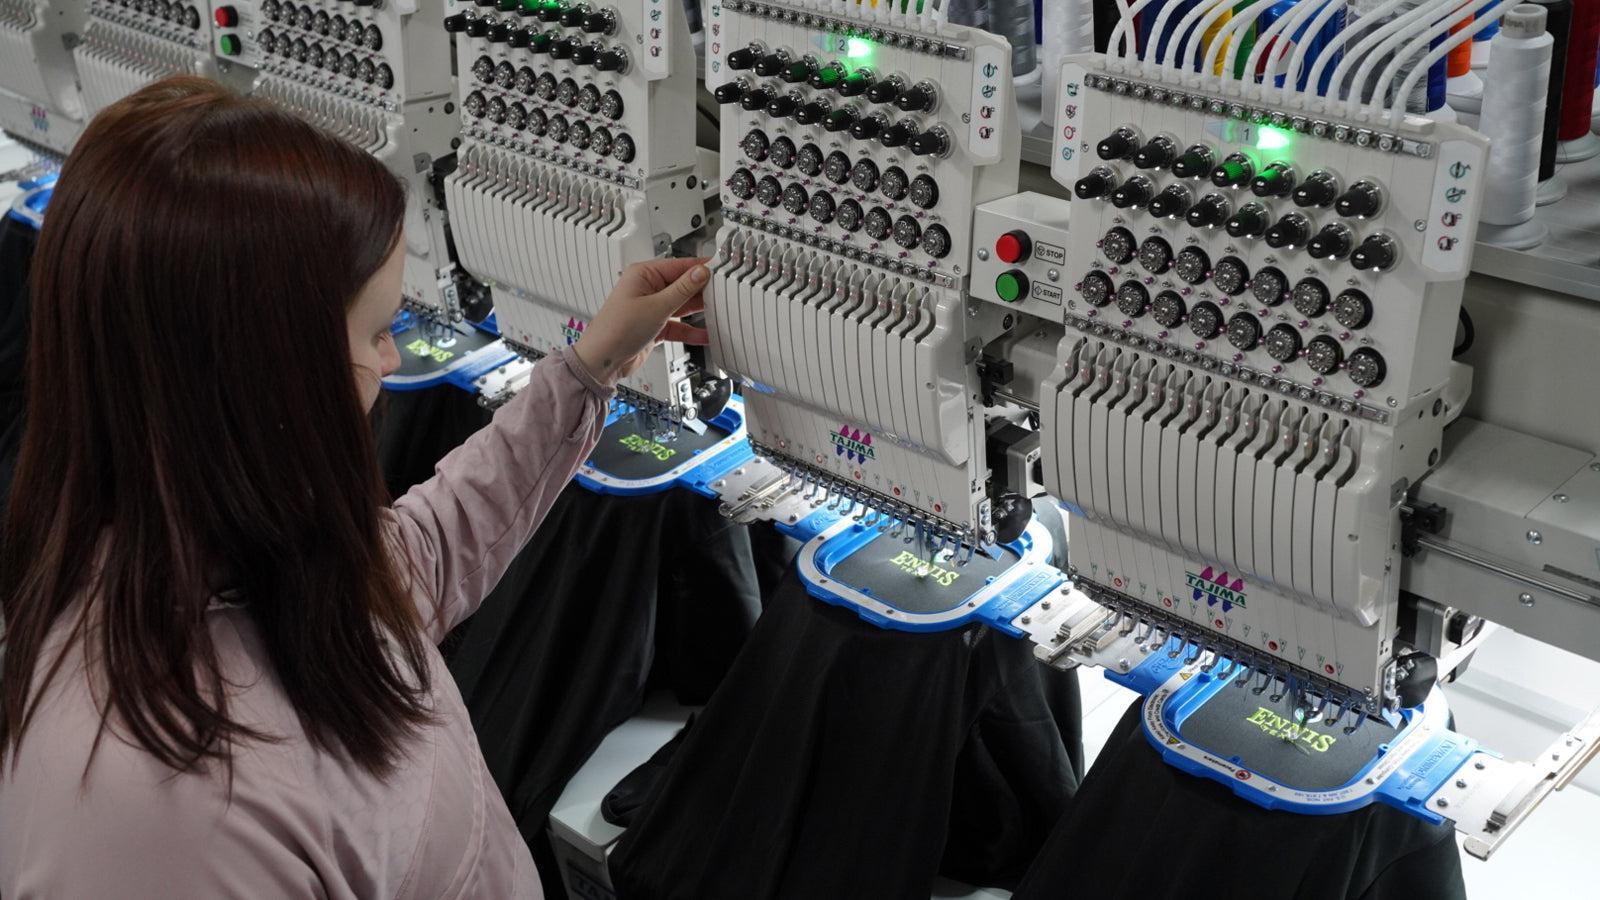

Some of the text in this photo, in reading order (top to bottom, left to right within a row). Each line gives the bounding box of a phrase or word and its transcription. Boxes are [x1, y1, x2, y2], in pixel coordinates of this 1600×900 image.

[838, 39, 846, 51] 2
[1243, 128, 1250, 141] 1
[1045, 249, 1064, 260] STOP
[1042, 289, 1061, 299] START
[830, 432, 875, 457] TAJIMA
[1186, 574, 1246, 606] TAJIMA
[1246, 706, 1336, 752] ENNIS
